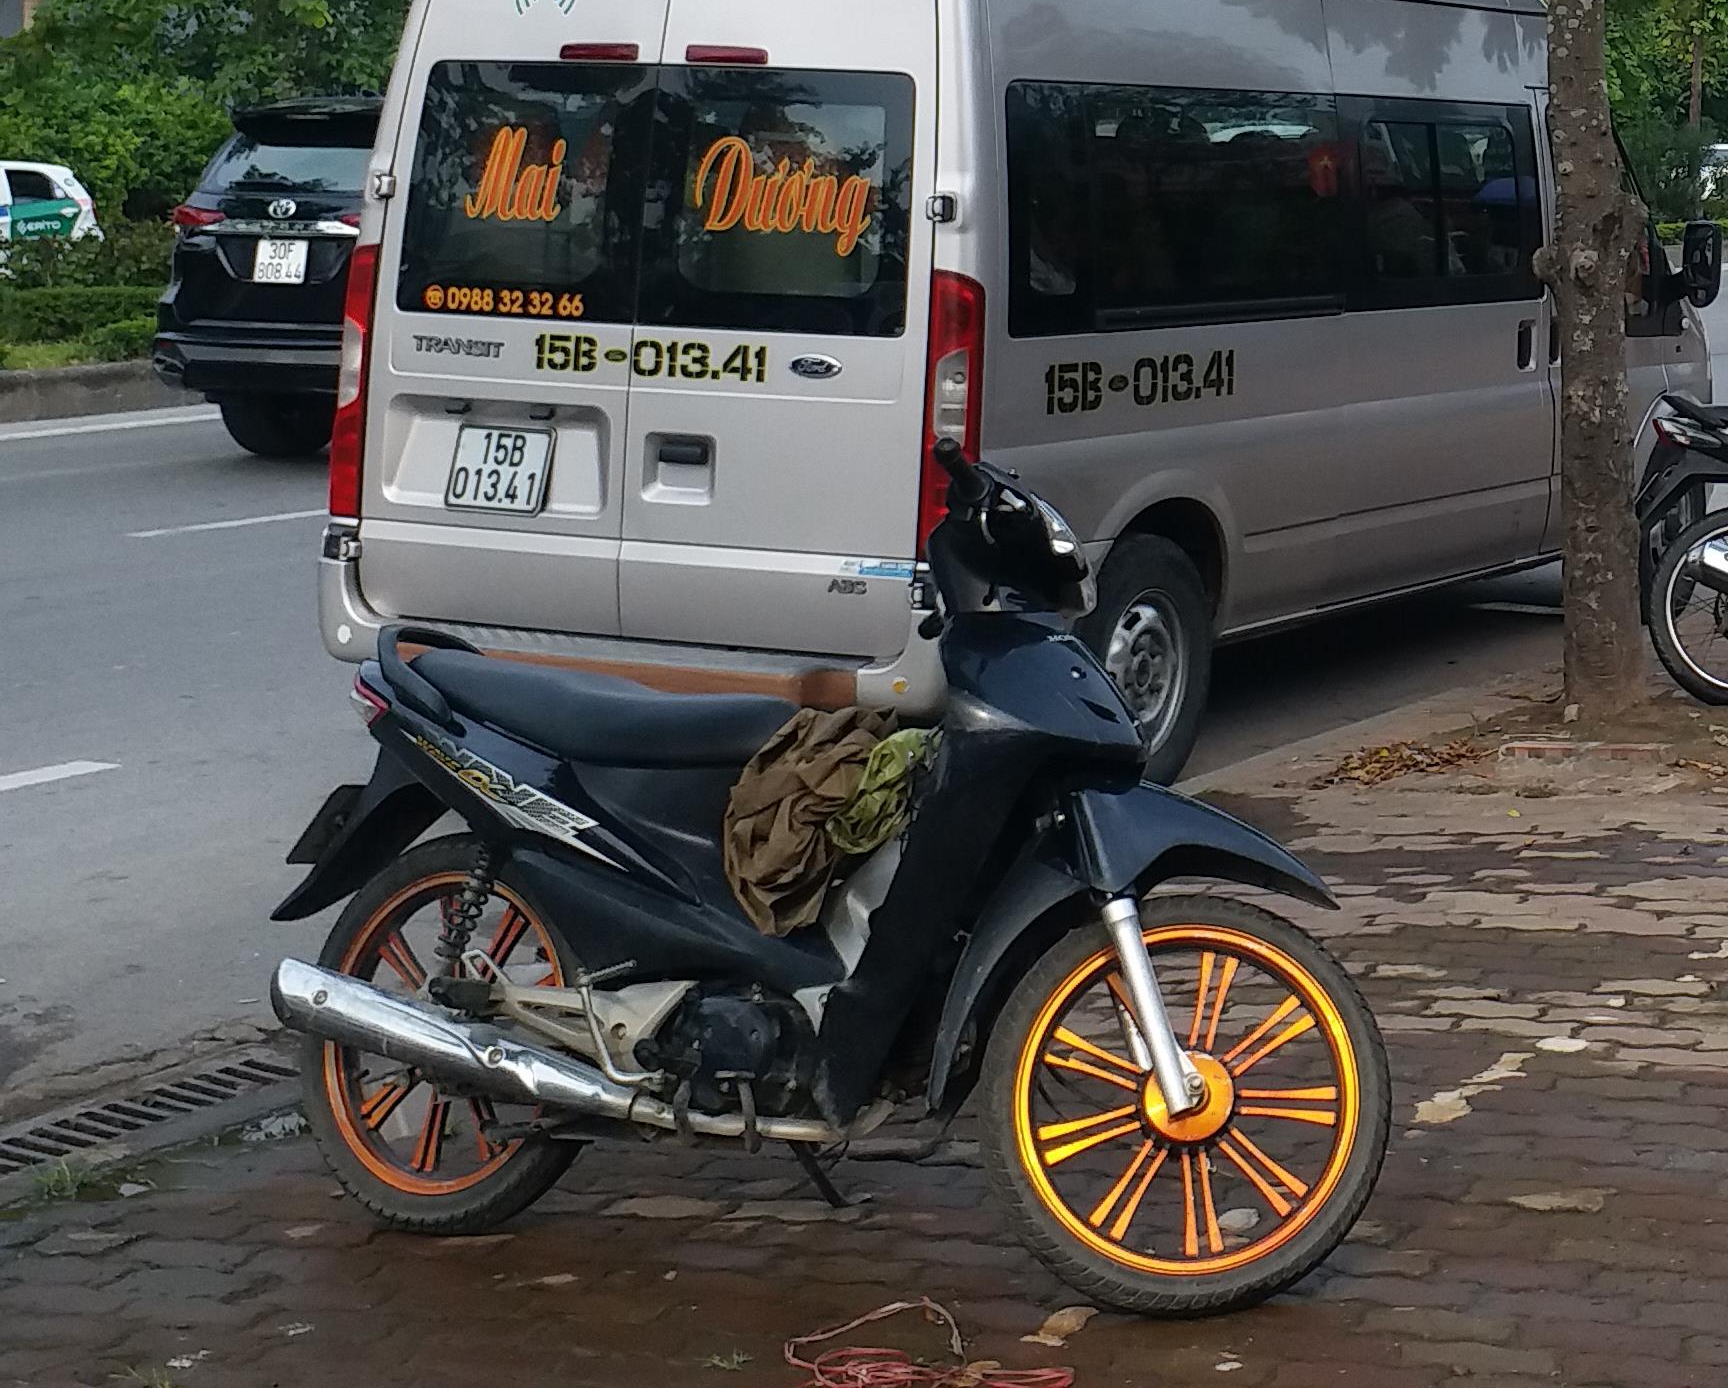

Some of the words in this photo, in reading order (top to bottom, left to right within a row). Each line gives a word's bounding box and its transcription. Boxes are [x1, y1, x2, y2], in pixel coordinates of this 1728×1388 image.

[467, 125, 567, 222] Mai
[696, 135, 872, 257] Dương
[269, 242, 296, 260] 30F
[446, 286, 494, 311] 0988
[498, 289, 524, 314] 32
[527, 291, 553, 315] 32
[557, 293, 584, 317] 66
[413, 334, 505, 359] TRANSIT
[482, 432, 527, 467] 15B
[452, 466, 537, 506] 013.41
[827, 578, 868, 596] ABS
